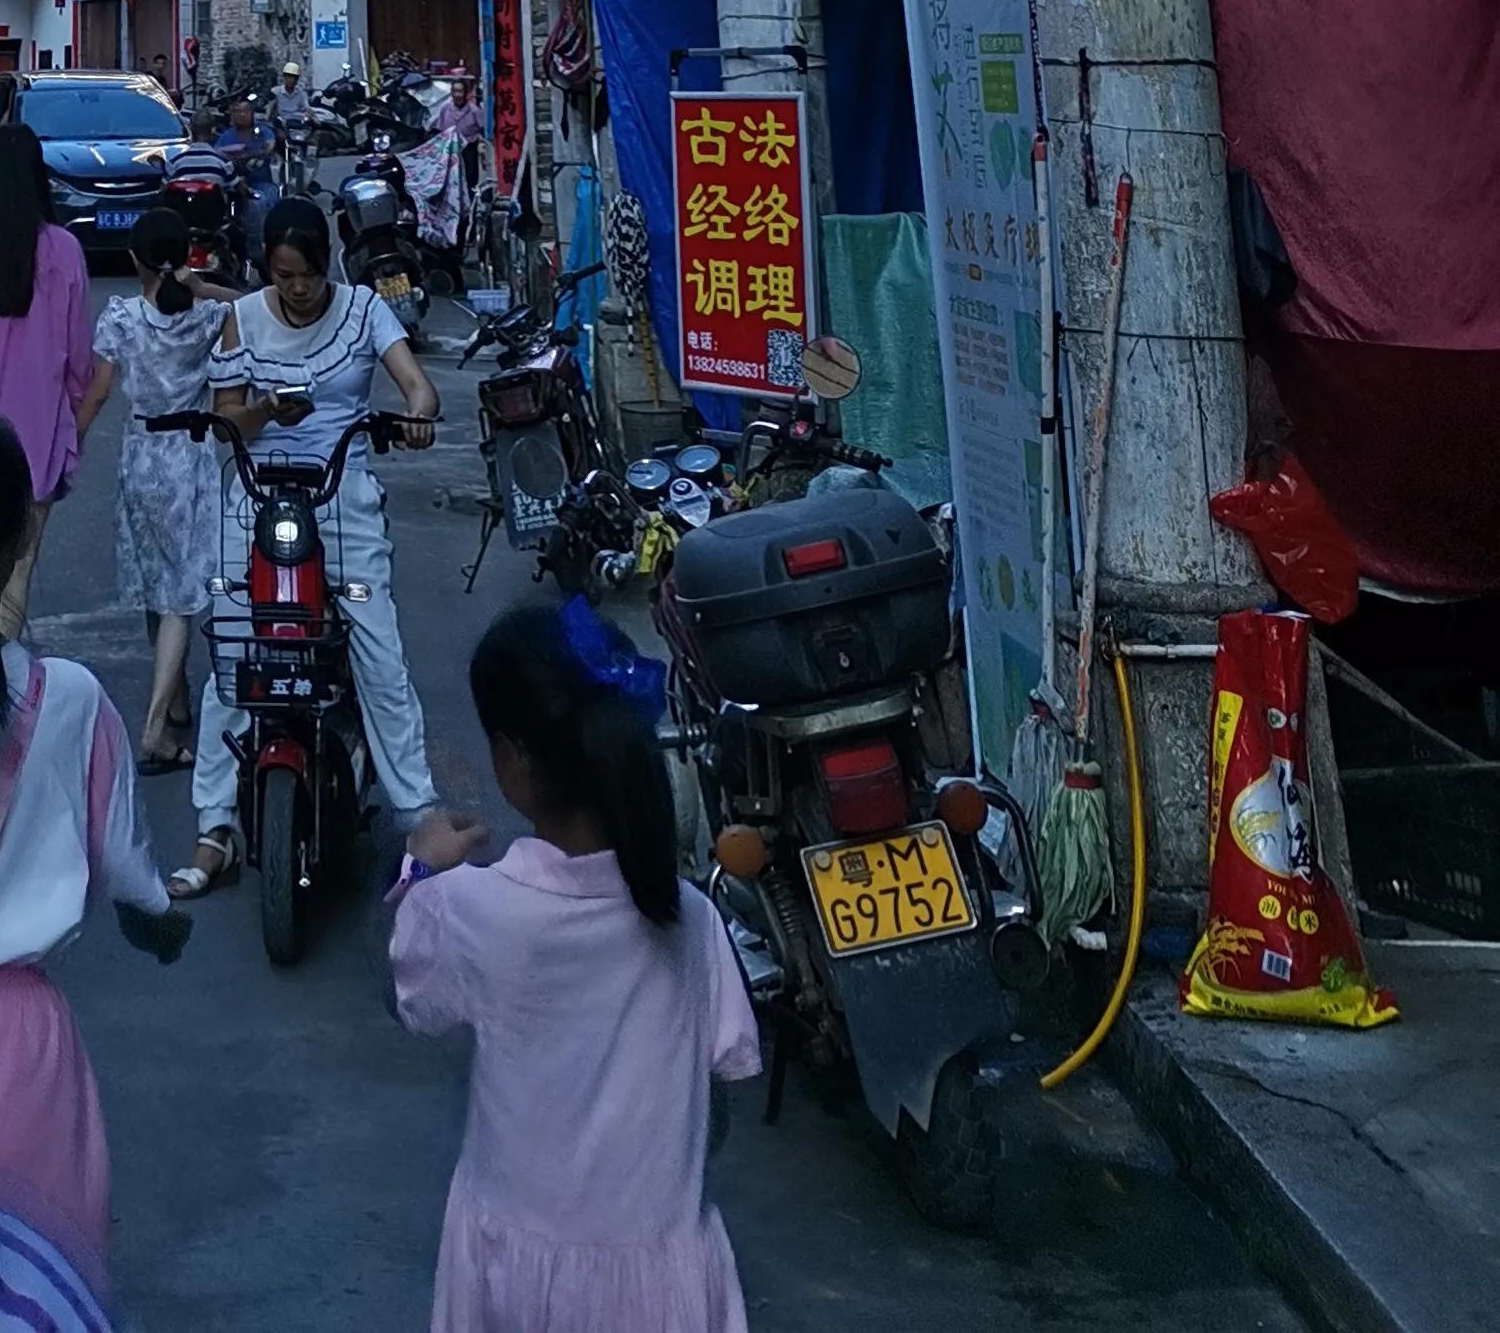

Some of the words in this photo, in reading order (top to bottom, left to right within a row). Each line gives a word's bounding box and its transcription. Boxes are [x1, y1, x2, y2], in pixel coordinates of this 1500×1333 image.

[681, 107, 796, 169] 古法
[683, 183, 800, 247] 经络
[685, 258, 804, 328] 调理
[830, 876, 963, 944] G9752
